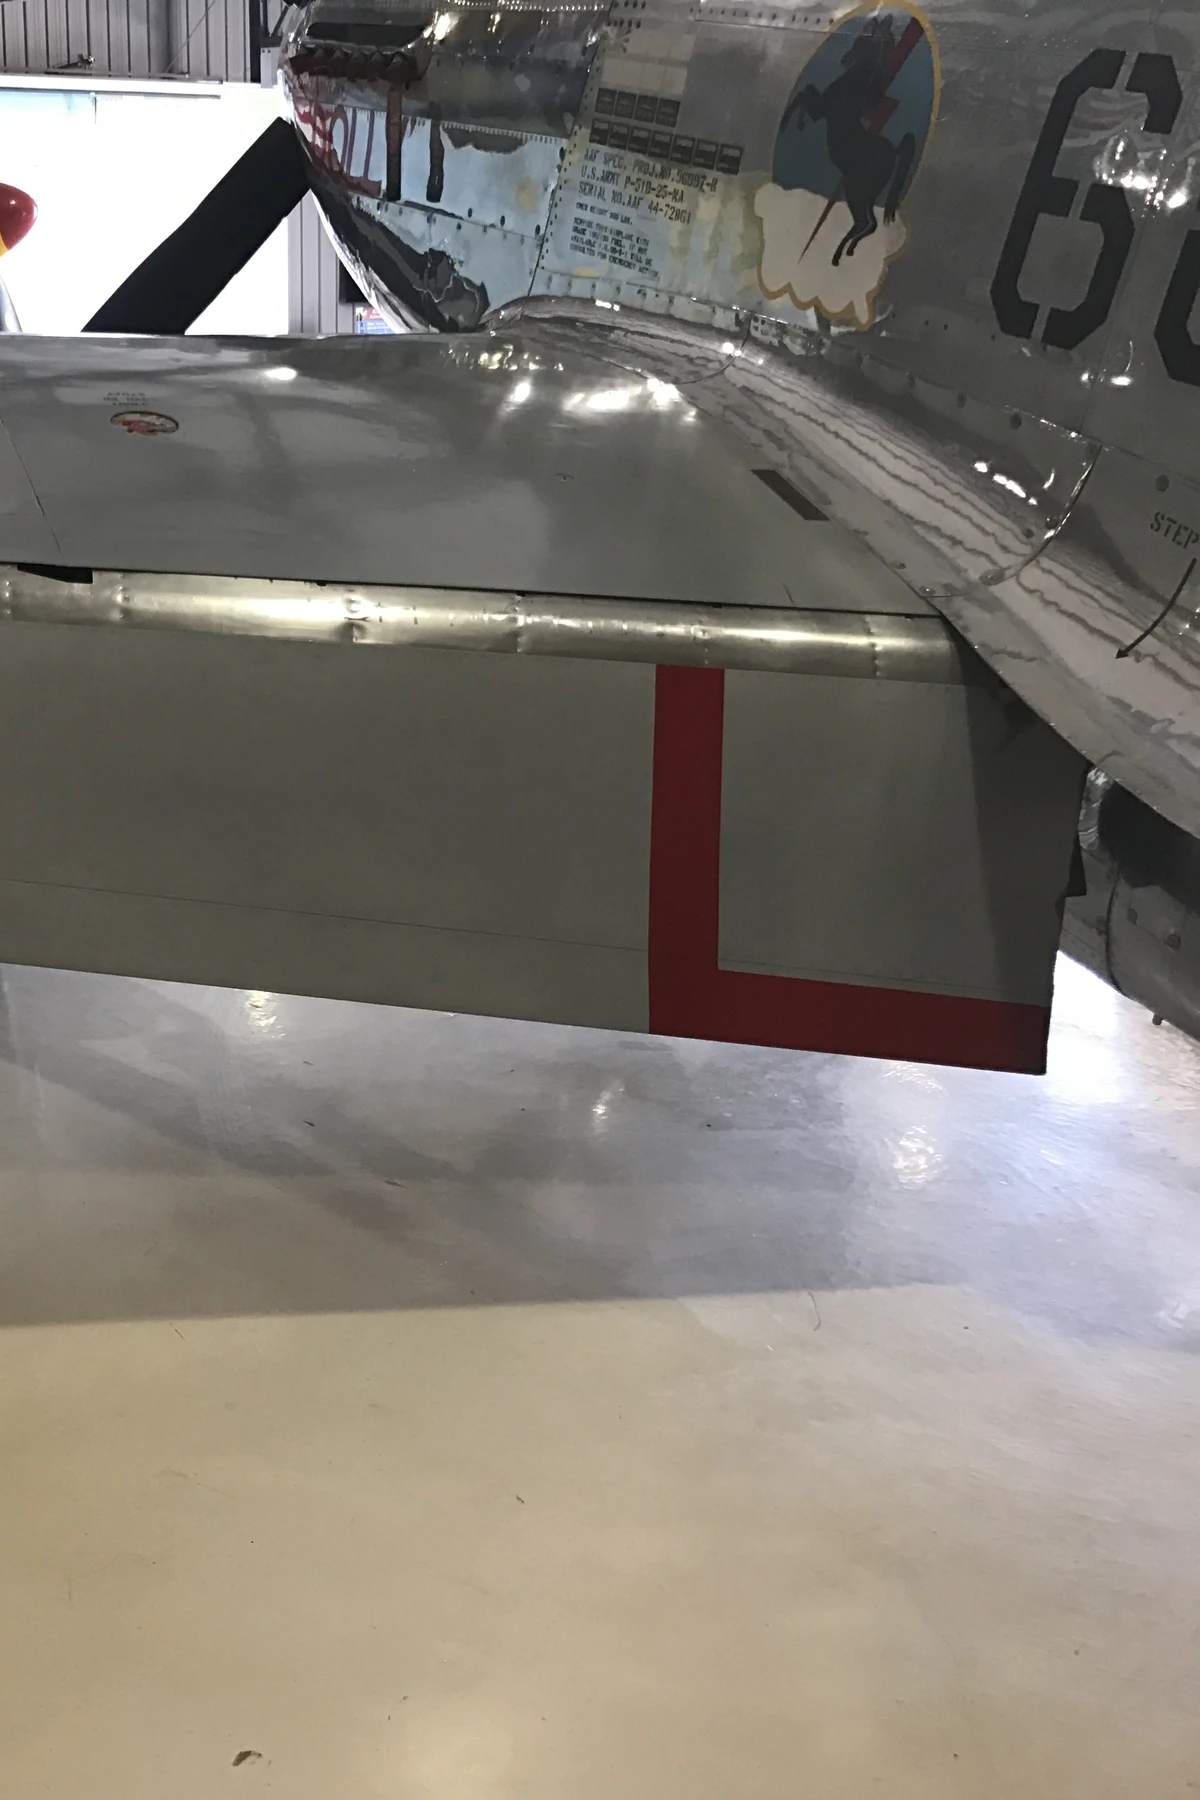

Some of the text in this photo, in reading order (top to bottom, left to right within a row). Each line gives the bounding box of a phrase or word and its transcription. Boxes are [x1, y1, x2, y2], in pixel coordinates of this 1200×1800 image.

[584, 148, 600, 163] AAF
[603, 152, 627, 170] SPEC.
[578, 180, 606, 201] SERIAL
[1150, 512, 1200, 548] STEP
